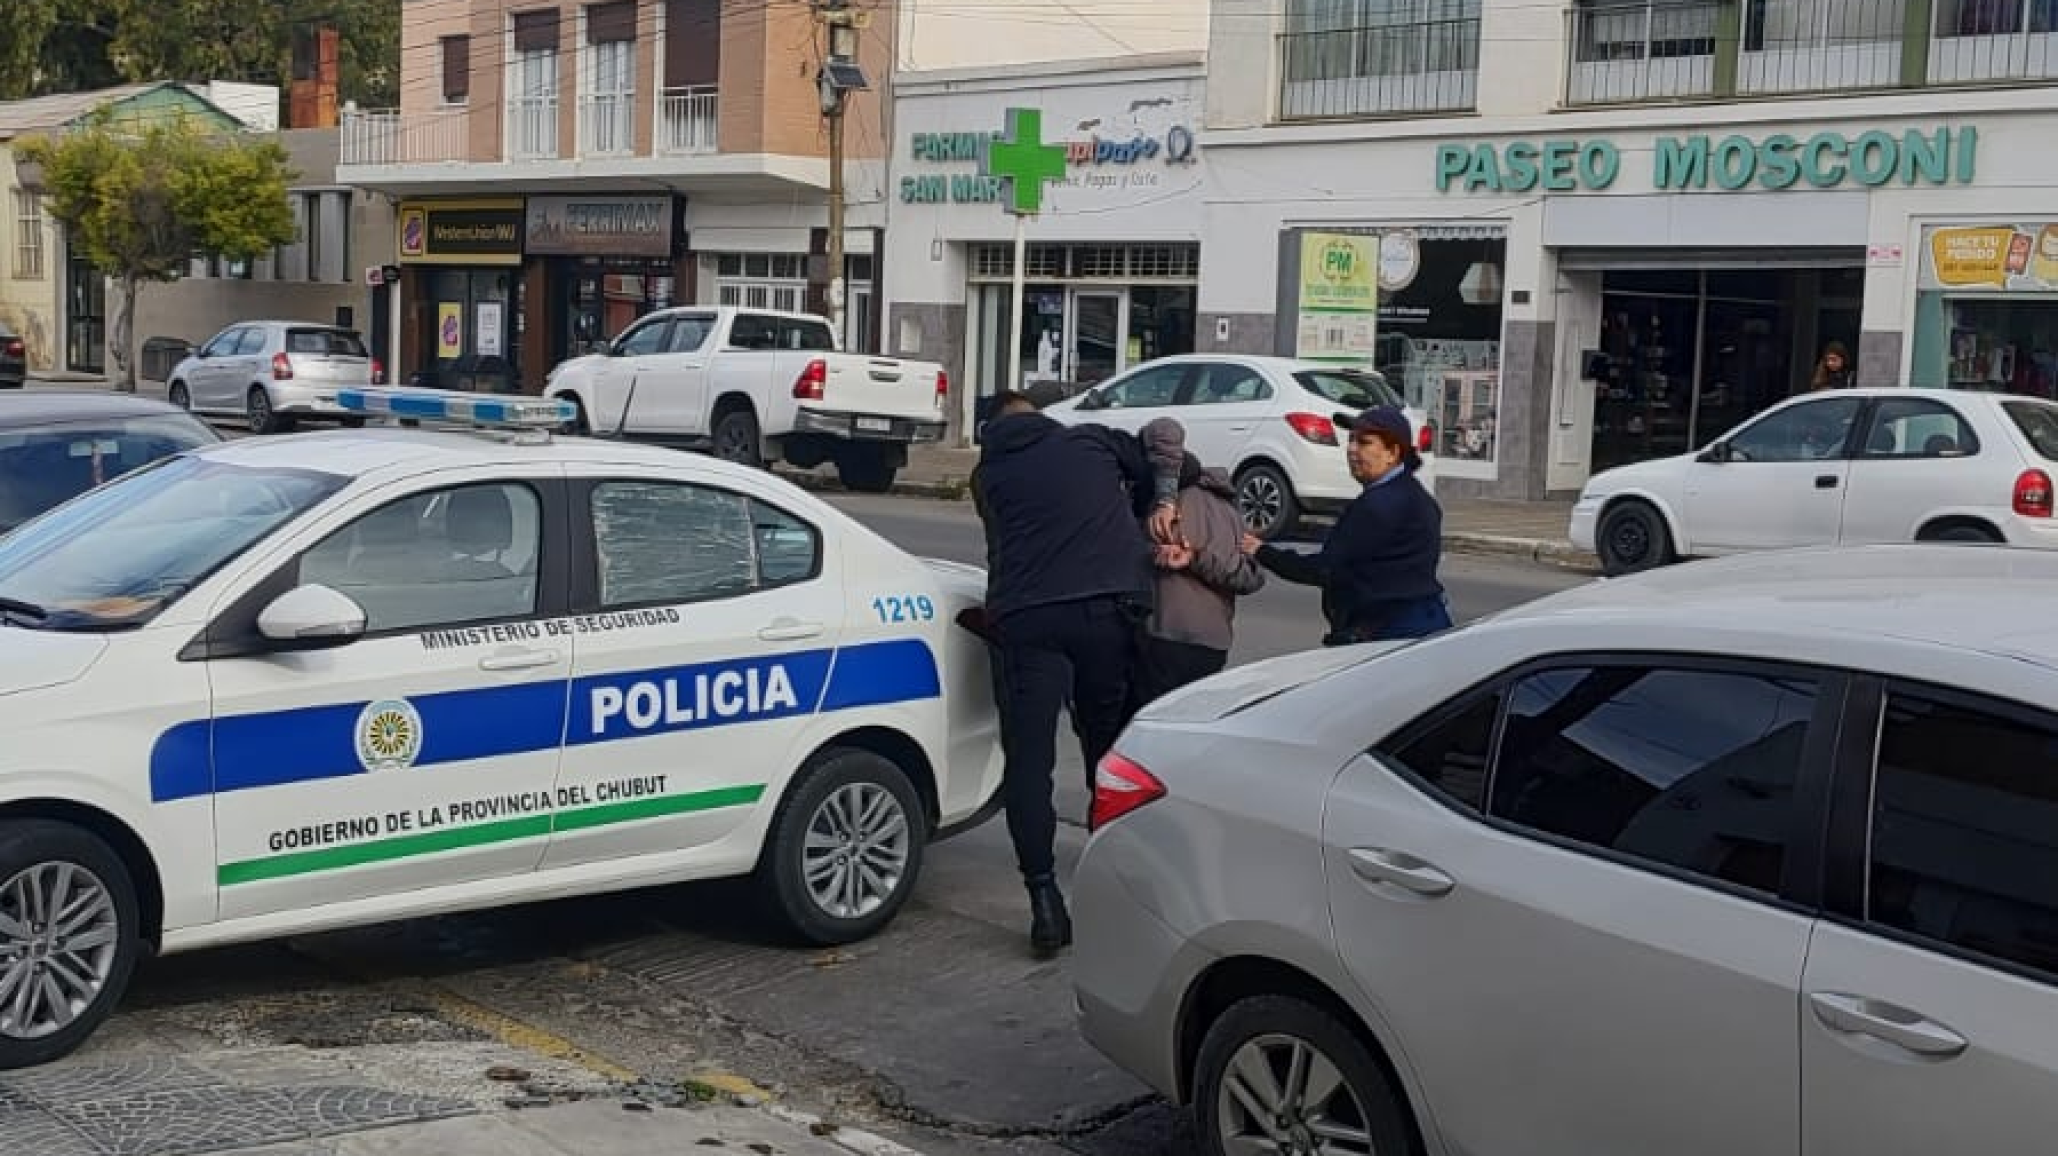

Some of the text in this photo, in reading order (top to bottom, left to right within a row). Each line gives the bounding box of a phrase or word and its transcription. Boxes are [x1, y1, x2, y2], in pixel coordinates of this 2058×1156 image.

[1435, 125, 1977, 192] PASEO MOSCONI
[900, 176, 947, 204] SAN
[1325, 251, 1352, 274] PM
[420, 608, 680, 650] MINISTERIO DE SEGURIDAD
[873, 594, 935, 623] 1219
[590, 664, 799, 734] POLICIA
[268, 775, 668, 852] GOBIERNO DE LA PROVINCIA DEL CHUBUT
